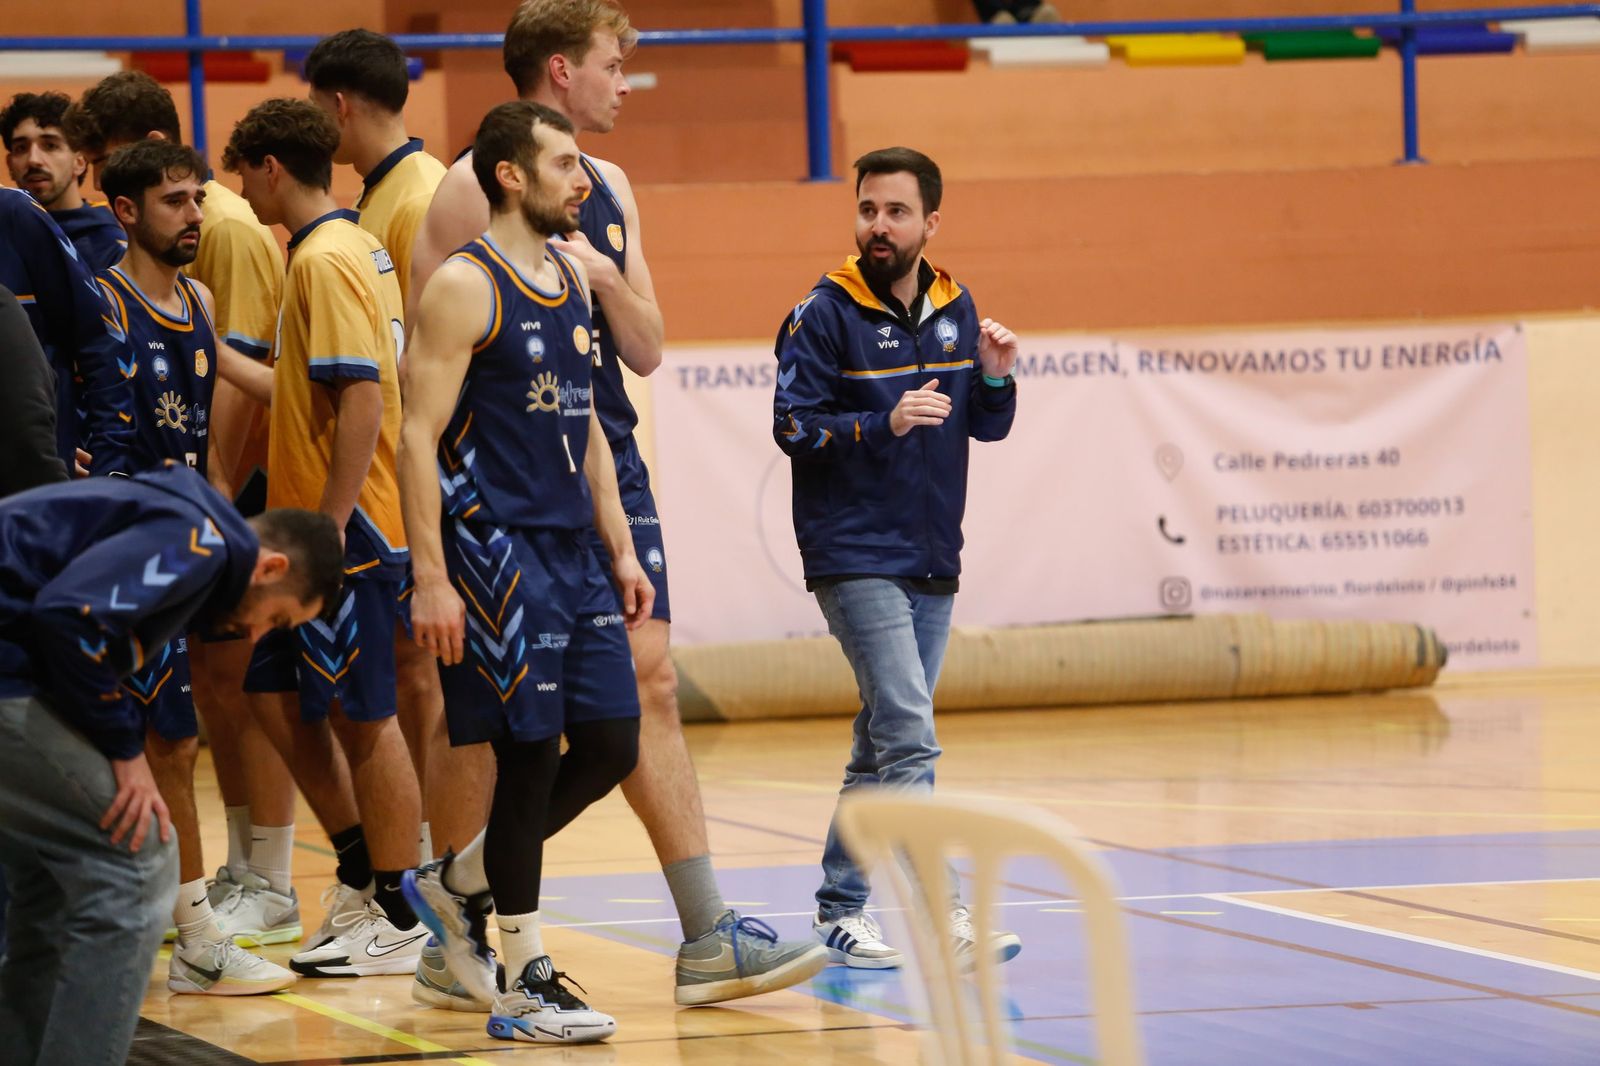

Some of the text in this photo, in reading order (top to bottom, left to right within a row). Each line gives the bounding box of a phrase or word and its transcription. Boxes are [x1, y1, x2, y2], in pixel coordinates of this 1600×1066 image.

[148, 341, 165, 350] vive
[878, 339, 900, 349] vive
[677, 335, 1503, 391] TRANS MAGEN, RENOVAMOS TU ENERGÍA
[1213, 448, 1401, 472] Calle Pedreras 40
[537, 682, 557, 692] vive
